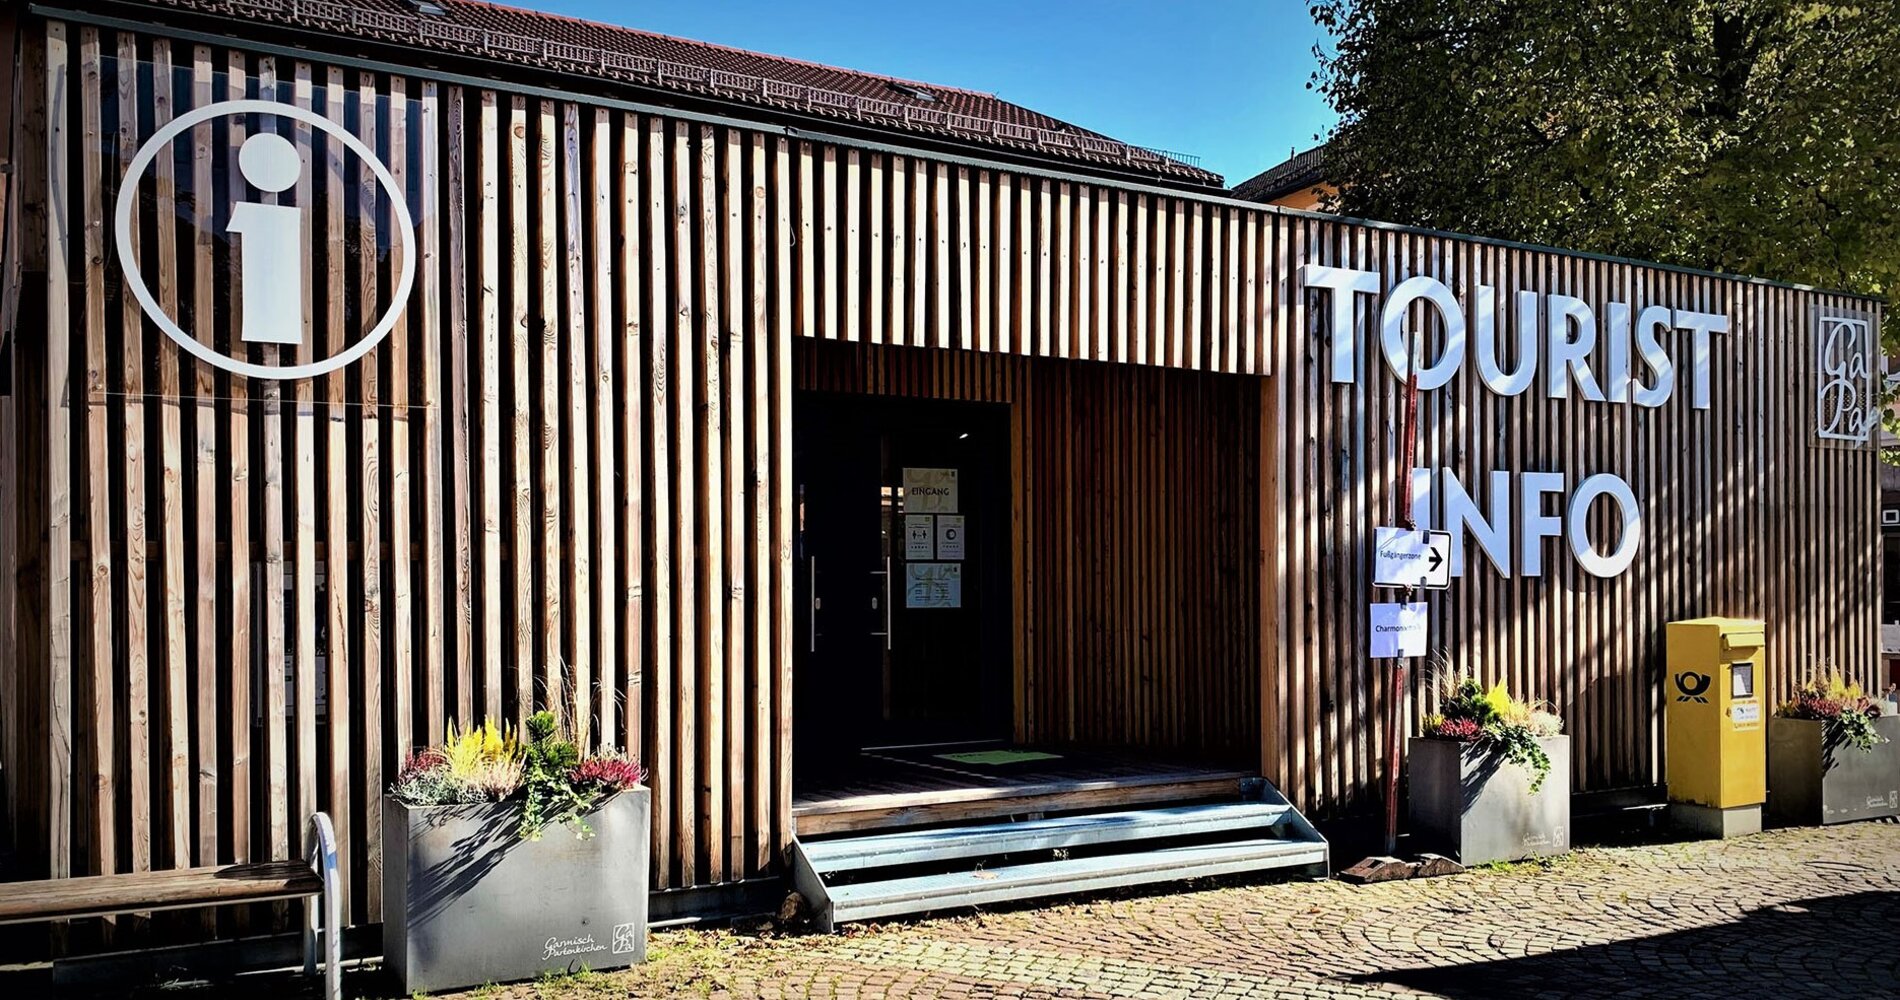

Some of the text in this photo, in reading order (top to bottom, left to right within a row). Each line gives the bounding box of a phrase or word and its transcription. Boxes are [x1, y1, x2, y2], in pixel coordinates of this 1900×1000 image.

[1304, 263, 1728, 410] TOURIST
[911, 487, 950, 496] EINGANG
[1411, 466, 1641, 579] INFO
[544, 933, 595, 950] Garmisch
[541, 943, 608, 961] Partenkirchen
